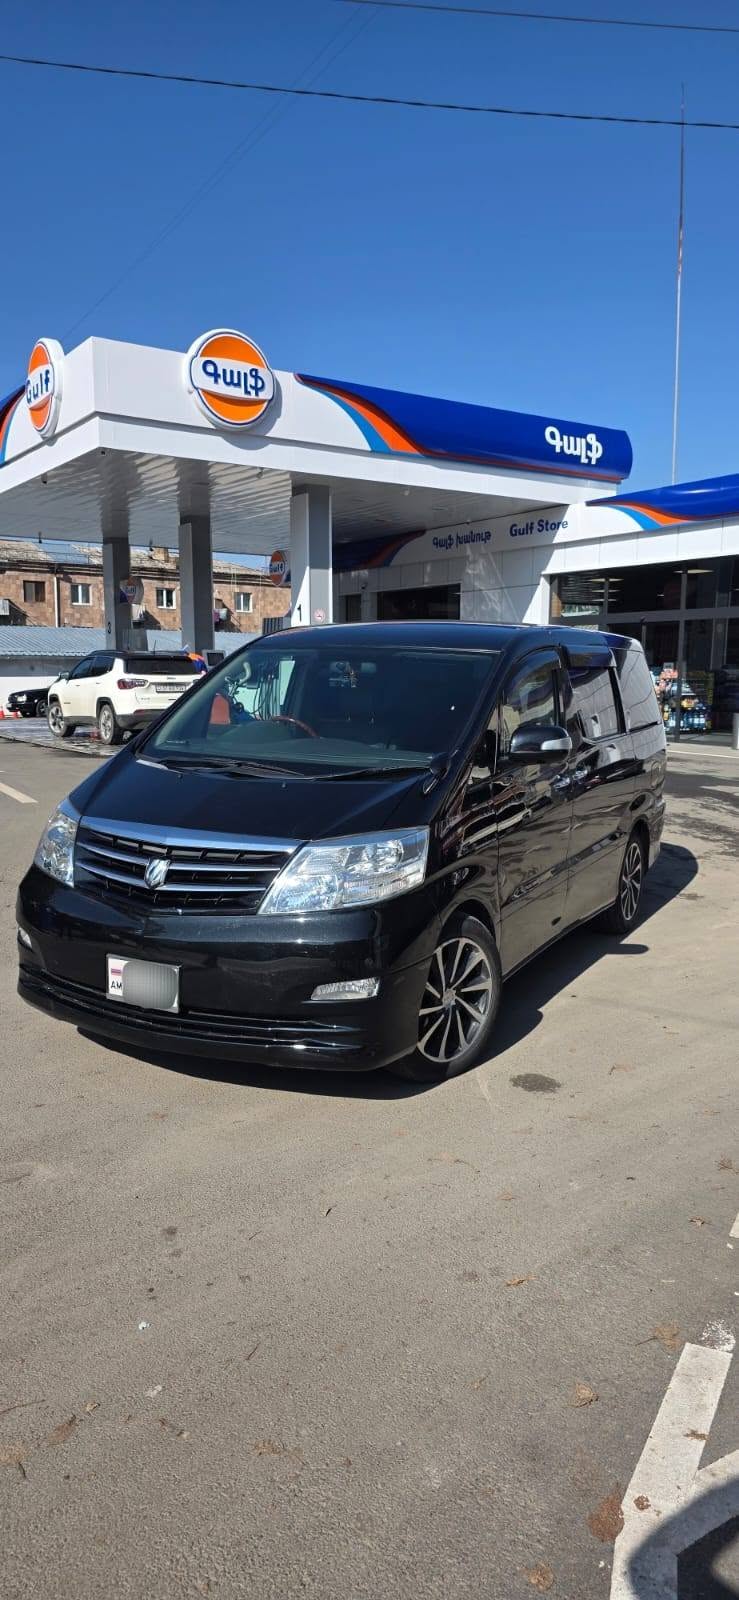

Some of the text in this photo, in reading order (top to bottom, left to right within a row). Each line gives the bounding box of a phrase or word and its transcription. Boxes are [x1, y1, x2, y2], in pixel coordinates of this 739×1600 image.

[25, 369, 50, 404] Gulf
[202, 359, 266, 397] Գալֆ
[544, 426, 603, 464] Գալֆ
[509, 519, 569, 537] Gulf Store
[432, 534, 454, 550] Գալֆ
[297, 604, 302, 622] 1
[107, 621, 112, 634] 3
[110, 980, 123, 991] AM
